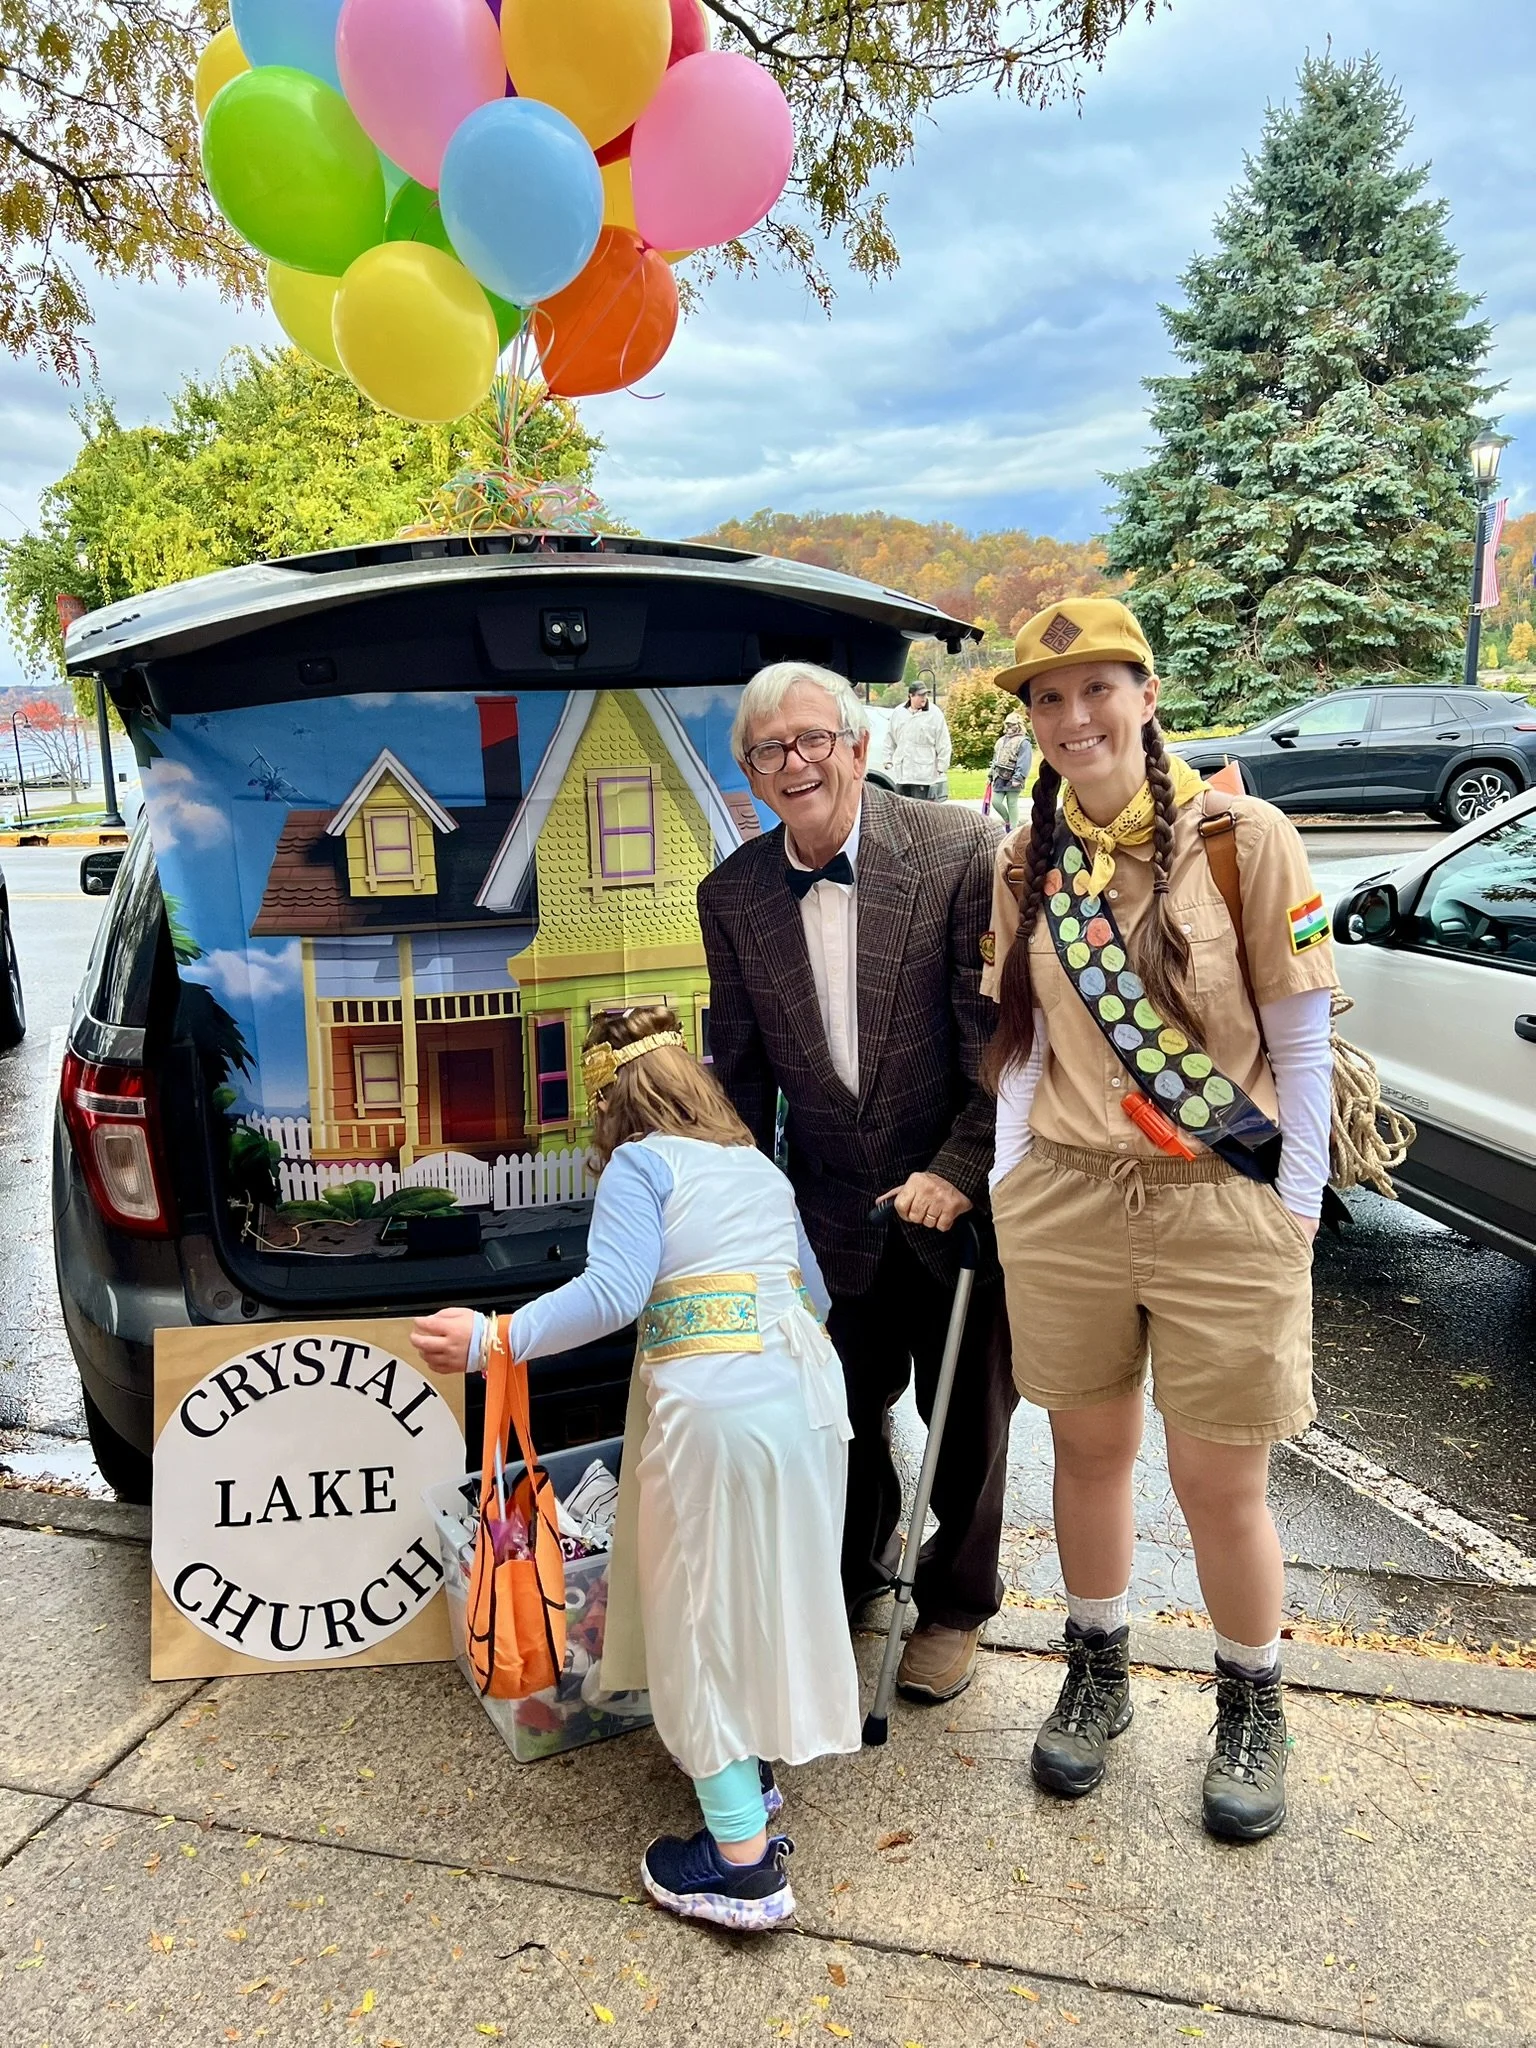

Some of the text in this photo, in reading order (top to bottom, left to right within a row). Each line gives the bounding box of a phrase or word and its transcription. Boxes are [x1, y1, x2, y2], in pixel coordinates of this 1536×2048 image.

[1380, 1083, 1429, 1110] EROKEE
[180, 1338, 438, 1438] CRYSTAL
[214, 1466, 397, 1528] LAKE
[173, 1537, 444, 1652] CHURCH
